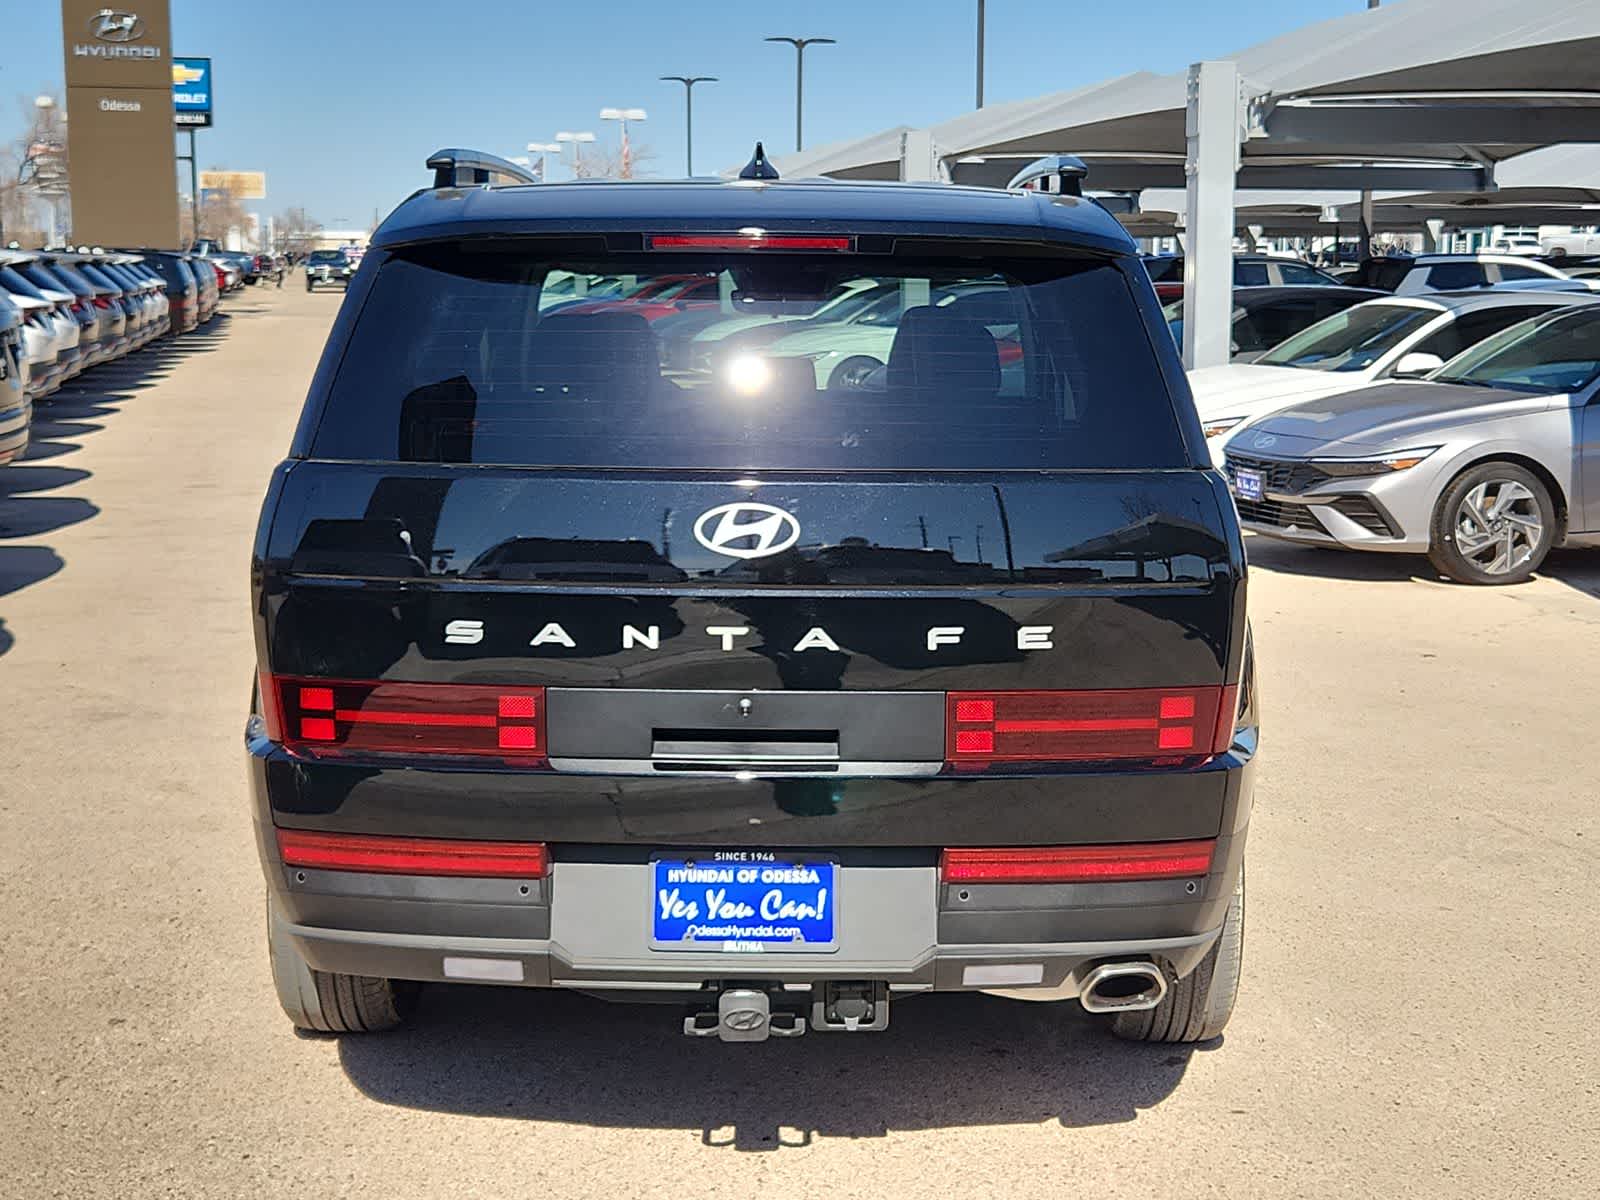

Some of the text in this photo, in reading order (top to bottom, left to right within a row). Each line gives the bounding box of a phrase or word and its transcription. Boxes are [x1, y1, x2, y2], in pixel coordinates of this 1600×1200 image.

[174, 93, 207, 104] ROLET
[100, 99, 141, 112] Odessa
[444, 619, 1054, 651] SANTA FE
[714, 852, 775, 861] SINCE 1946
[668, 869, 820, 884] HYUNDAI OF ODESSA
[659, 887, 827, 921] Yes You Can!
[688, 925, 801, 938] OdessaHyundai.com
